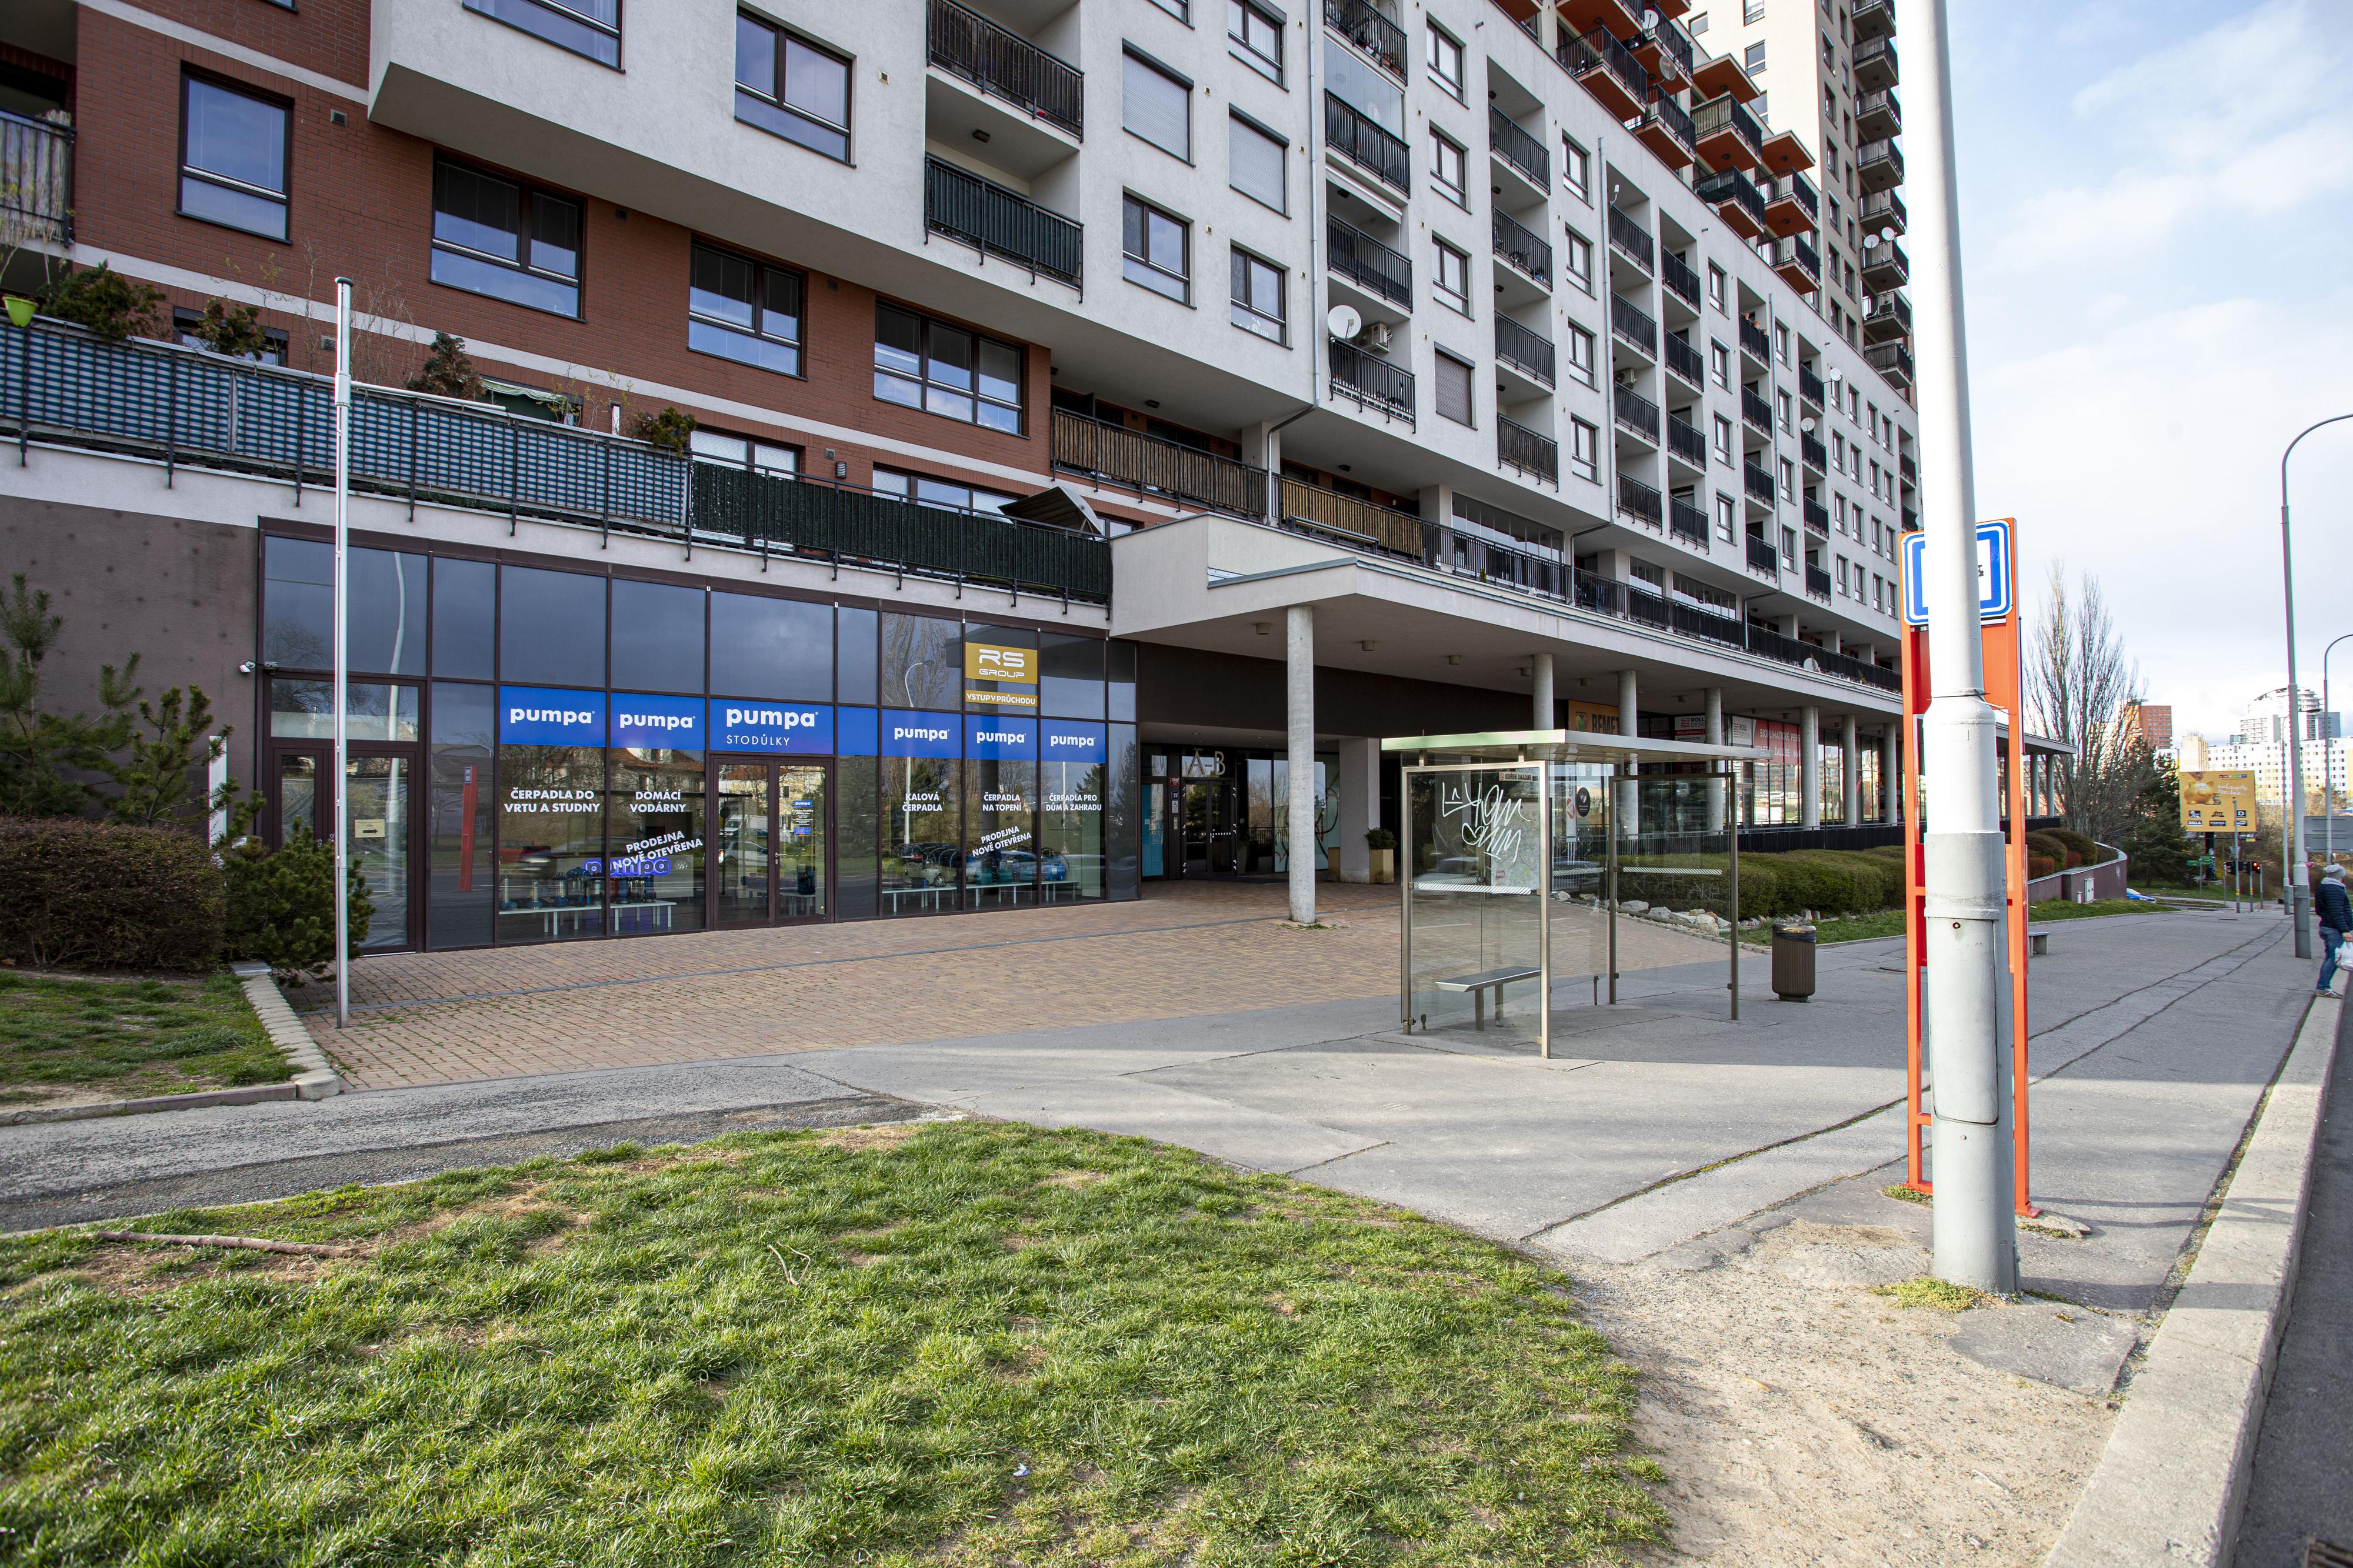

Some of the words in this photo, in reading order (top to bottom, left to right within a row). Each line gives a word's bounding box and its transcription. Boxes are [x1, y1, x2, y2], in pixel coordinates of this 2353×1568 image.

[979, 649, 1025, 668] RS
[979, 668, 1025, 678] GROUP
[996, 694, 1035, 705] PRŮCHODU
[510, 708, 592, 726] pumpa
[619, 713, 693, 730] pumpa
[726, 708, 815, 730] pumpa
[726, 733, 789, 746] STODŮLKY
[894, 727, 948, 741] pumpa
[976, 731, 1025, 745] pumpa
[1051, 735, 1094, 748] pumpa
[1188, 749, 1226, 775] A-B
[510, 786, 574, 800] ČERPADLA
[576, 790, 594, 800] DO
[635, 789, 681, 800] DOMÁCÍ
[905, 790, 939, 801] KALOVÁ
[984, 792, 1021, 801] ČERPADLA
[1049, 792, 1082, 802] ČERPADLA
[1084, 793, 1098, 802] PRO
[504, 803, 538, 813] VRTU
[539, 803, 549, 812] A
[552, 803, 601, 813] STUDNY
[629, 800, 686, 813] VODÁRNY
[902, 802, 942, 812] ČERPADLA
[982, 803, 994, 812] NA
[995, 801, 1022, 812] TOPENÍ
[1046, 800, 1062, 811] DŮM
[1069, 803, 1102, 811] ZAHRADU
[981, 826, 1020, 843] PRODEJNA
[626, 830, 685, 853] PRODEJNA
[972, 842, 994, 857] NOVĚ
[994, 832, 1032, 849] OTEVŘENA
[612, 850, 645, 870] NOVĚ
[647, 838, 704, 860] OTEVŘENA
